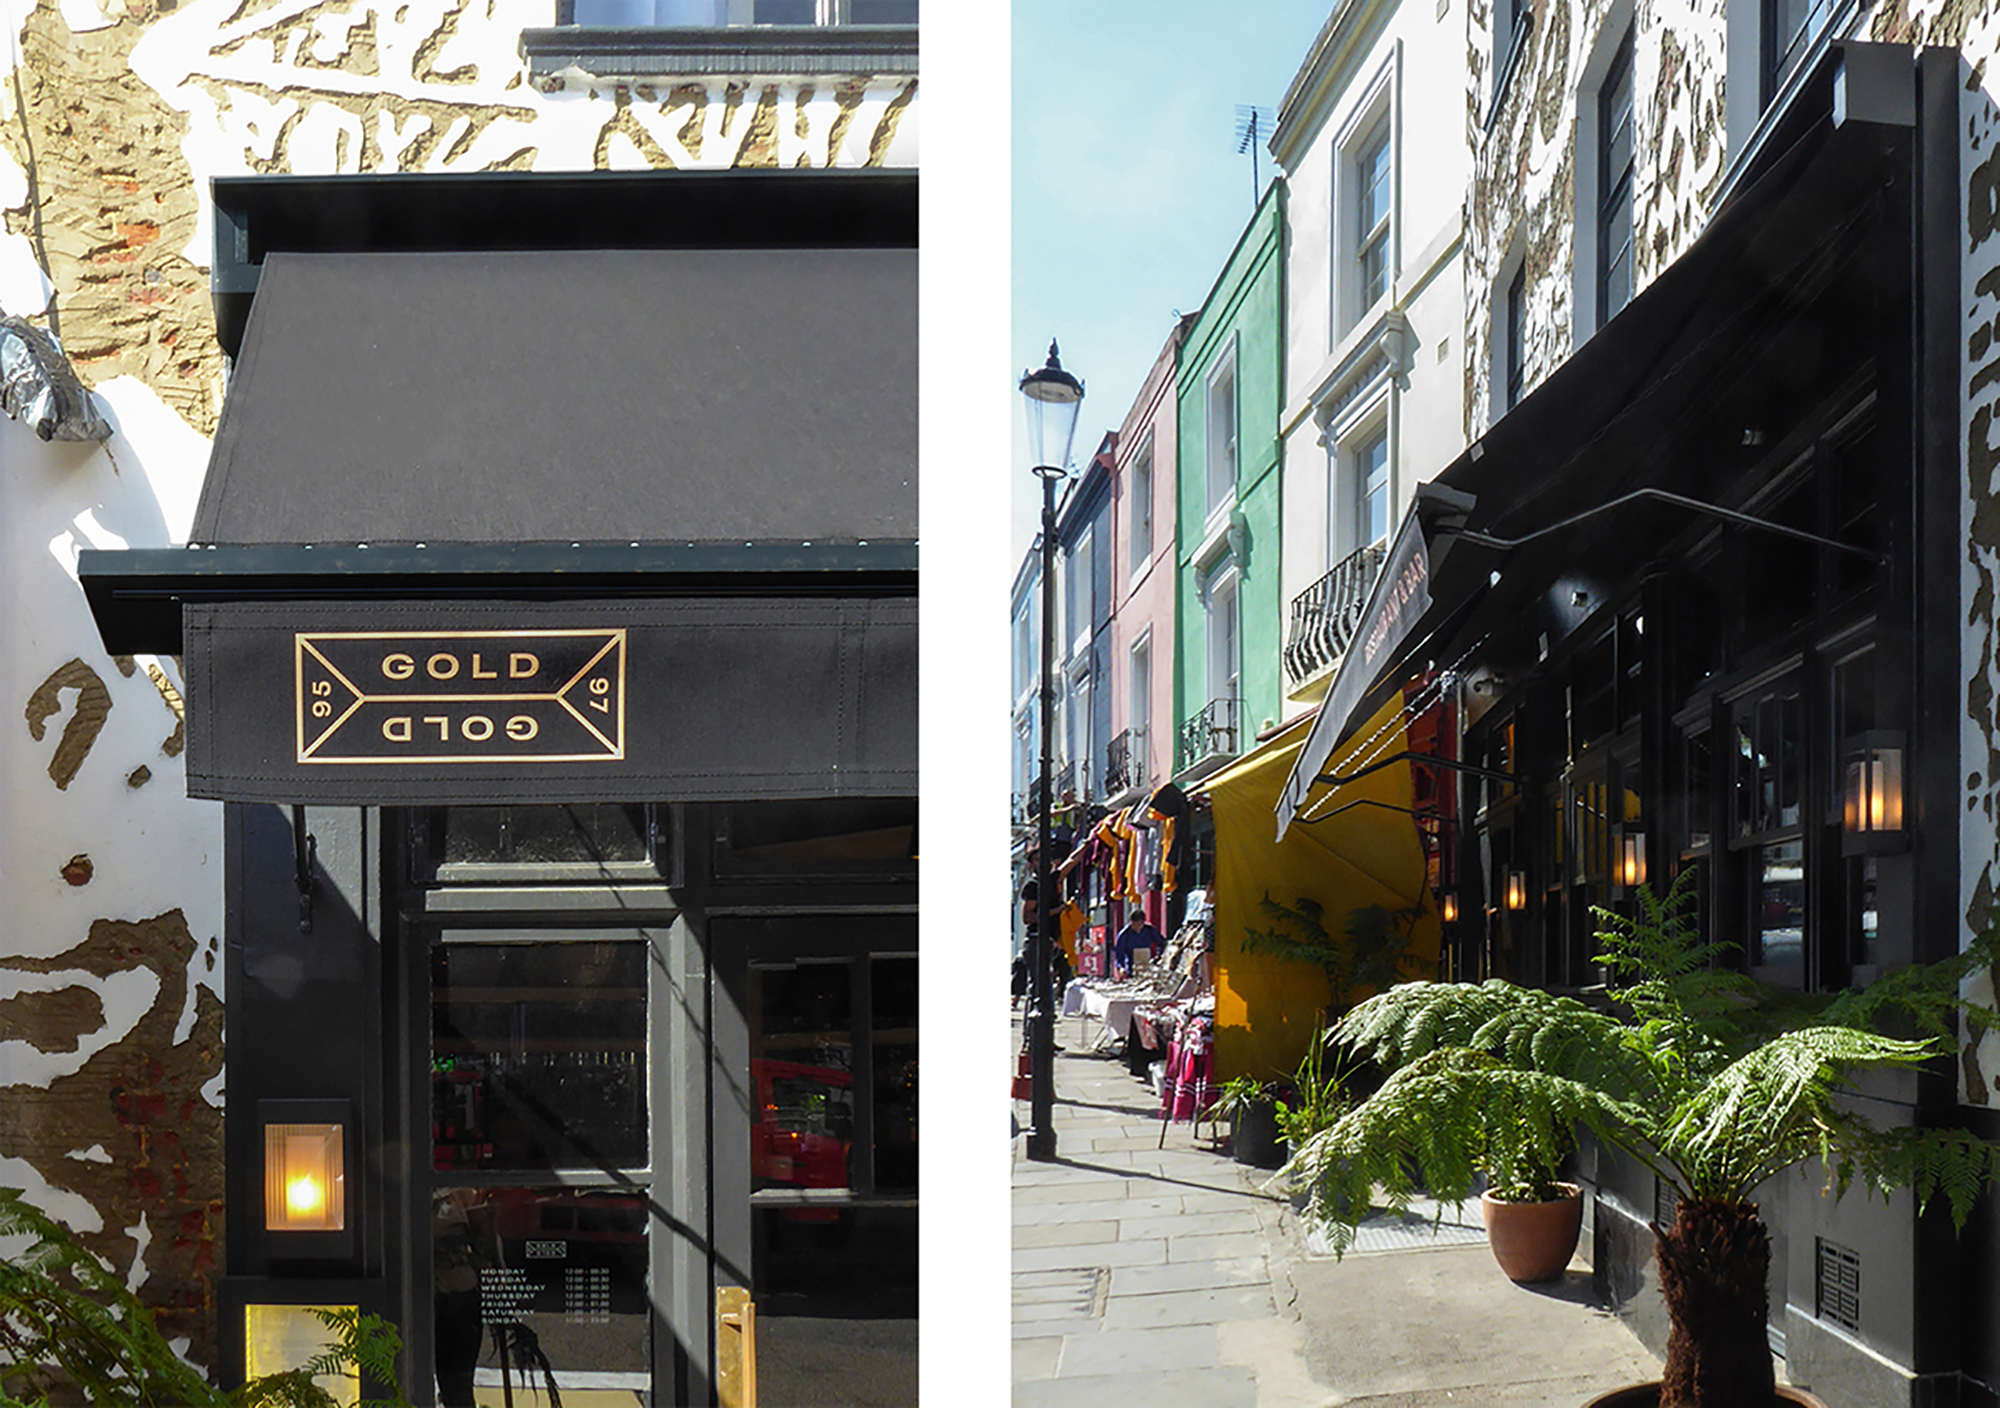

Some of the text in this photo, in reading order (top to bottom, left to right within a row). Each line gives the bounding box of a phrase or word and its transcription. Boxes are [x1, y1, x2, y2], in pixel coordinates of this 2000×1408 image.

[1404, 553, 1427, 595] BAR
[381, 652, 540, 680] GOLD
[311, 680, 333, 718] 95
[588, 677, 610, 714] 97
[381, 715, 540, 741] GOLD
[481, 1292, 536, 1300] THURSDAY
